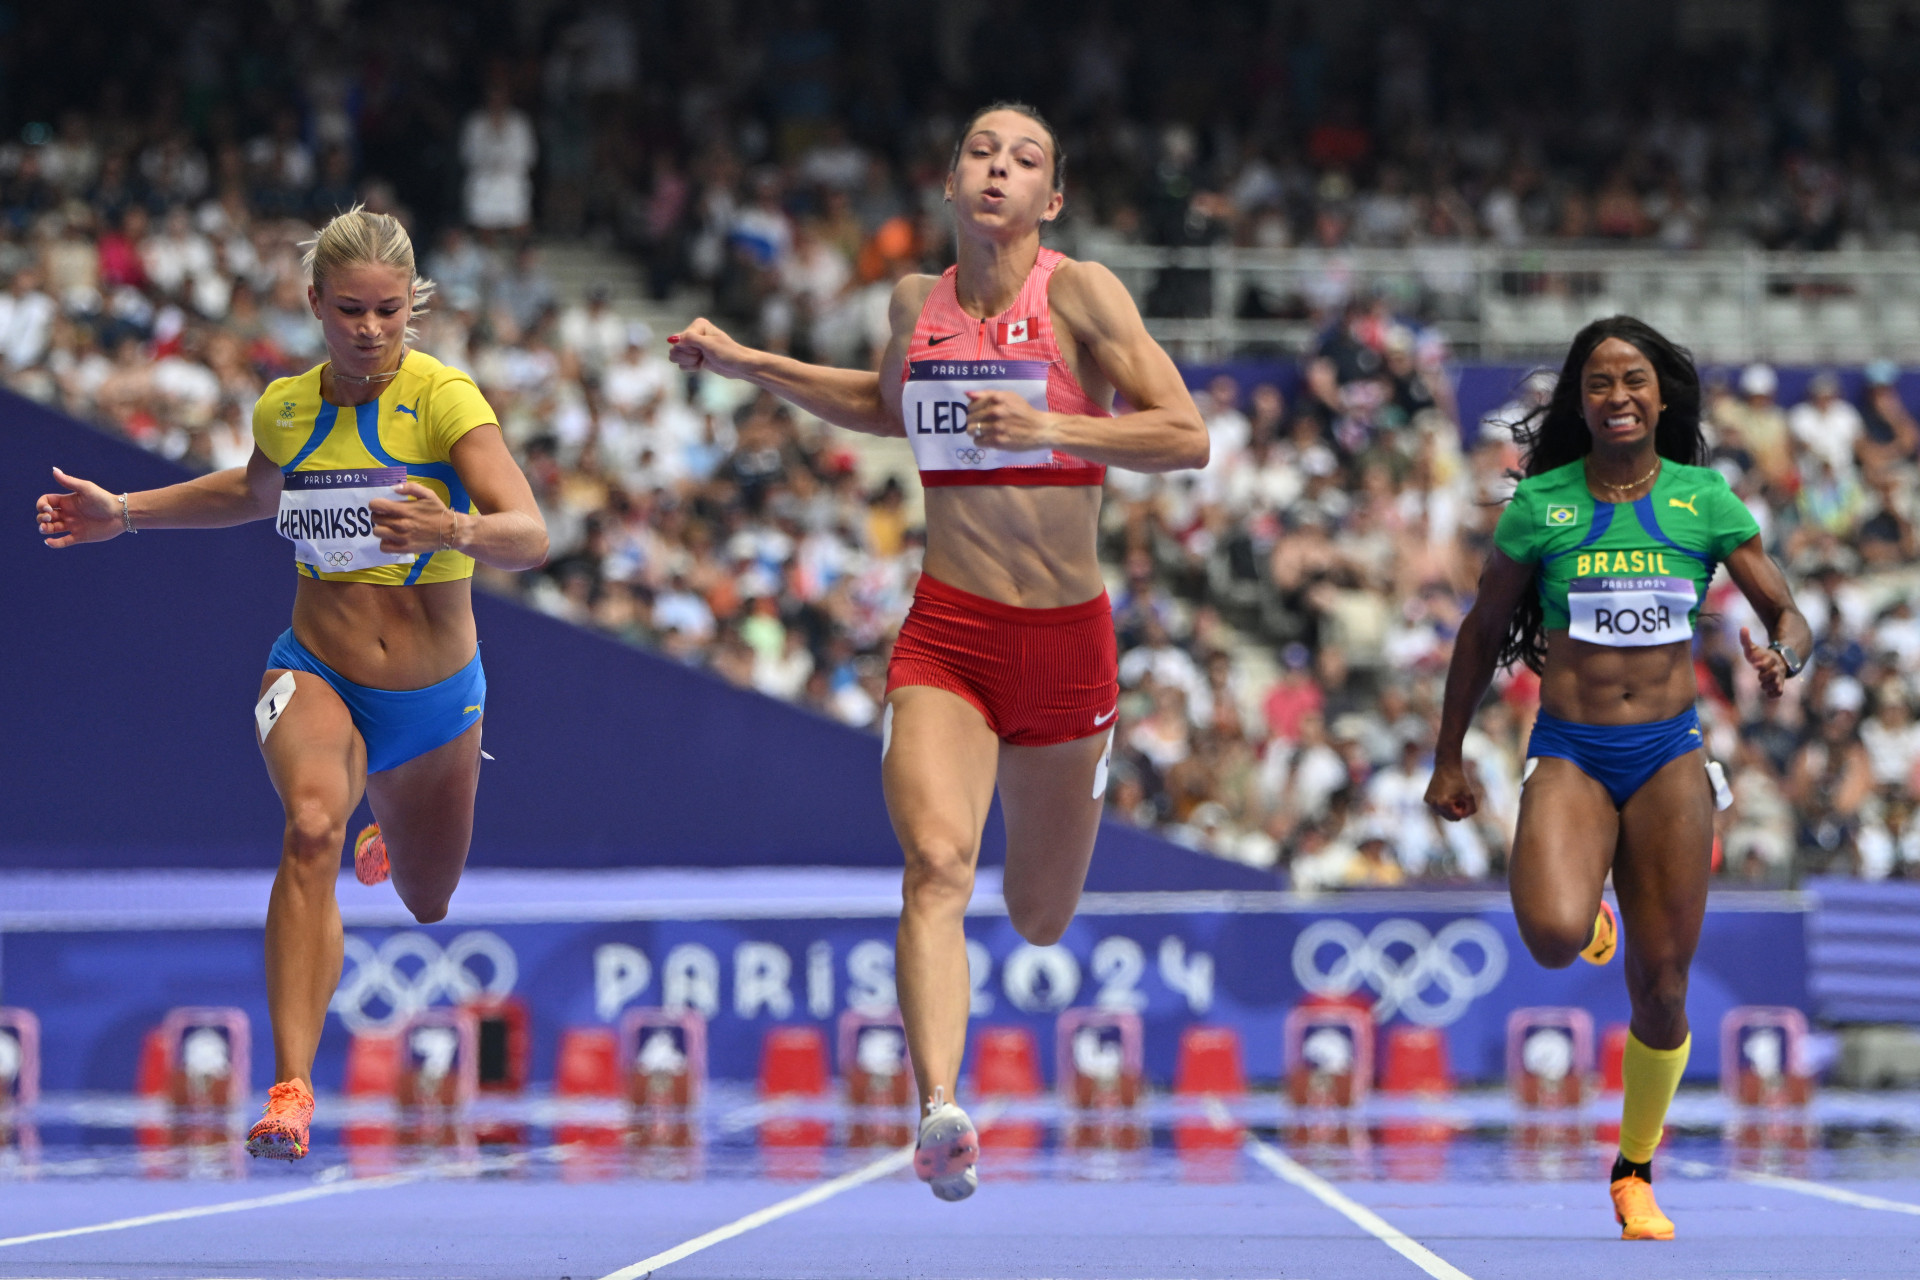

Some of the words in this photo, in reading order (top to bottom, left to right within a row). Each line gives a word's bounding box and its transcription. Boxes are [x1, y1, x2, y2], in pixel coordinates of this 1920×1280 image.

[932, 365, 969, 376] PARIS
[972, 365, 1006, 376] 2024
[276, 418, 294, 428] SWE
[917, 401, 969, 435] LED
[304, 474, 332, 485] PARIS
[336, 473, 368, 484] 2024
[280, 506, 376, 540] HENRIKSS
[1577, 550, 1670, 577] BRASIL
[1601, 579, 1634, 589] PARIS
[1636, 578, 1667, 589] 2024
[1595, 605, 1671, 635] ROSA
[593, 940, 897, 1020] PARIS
